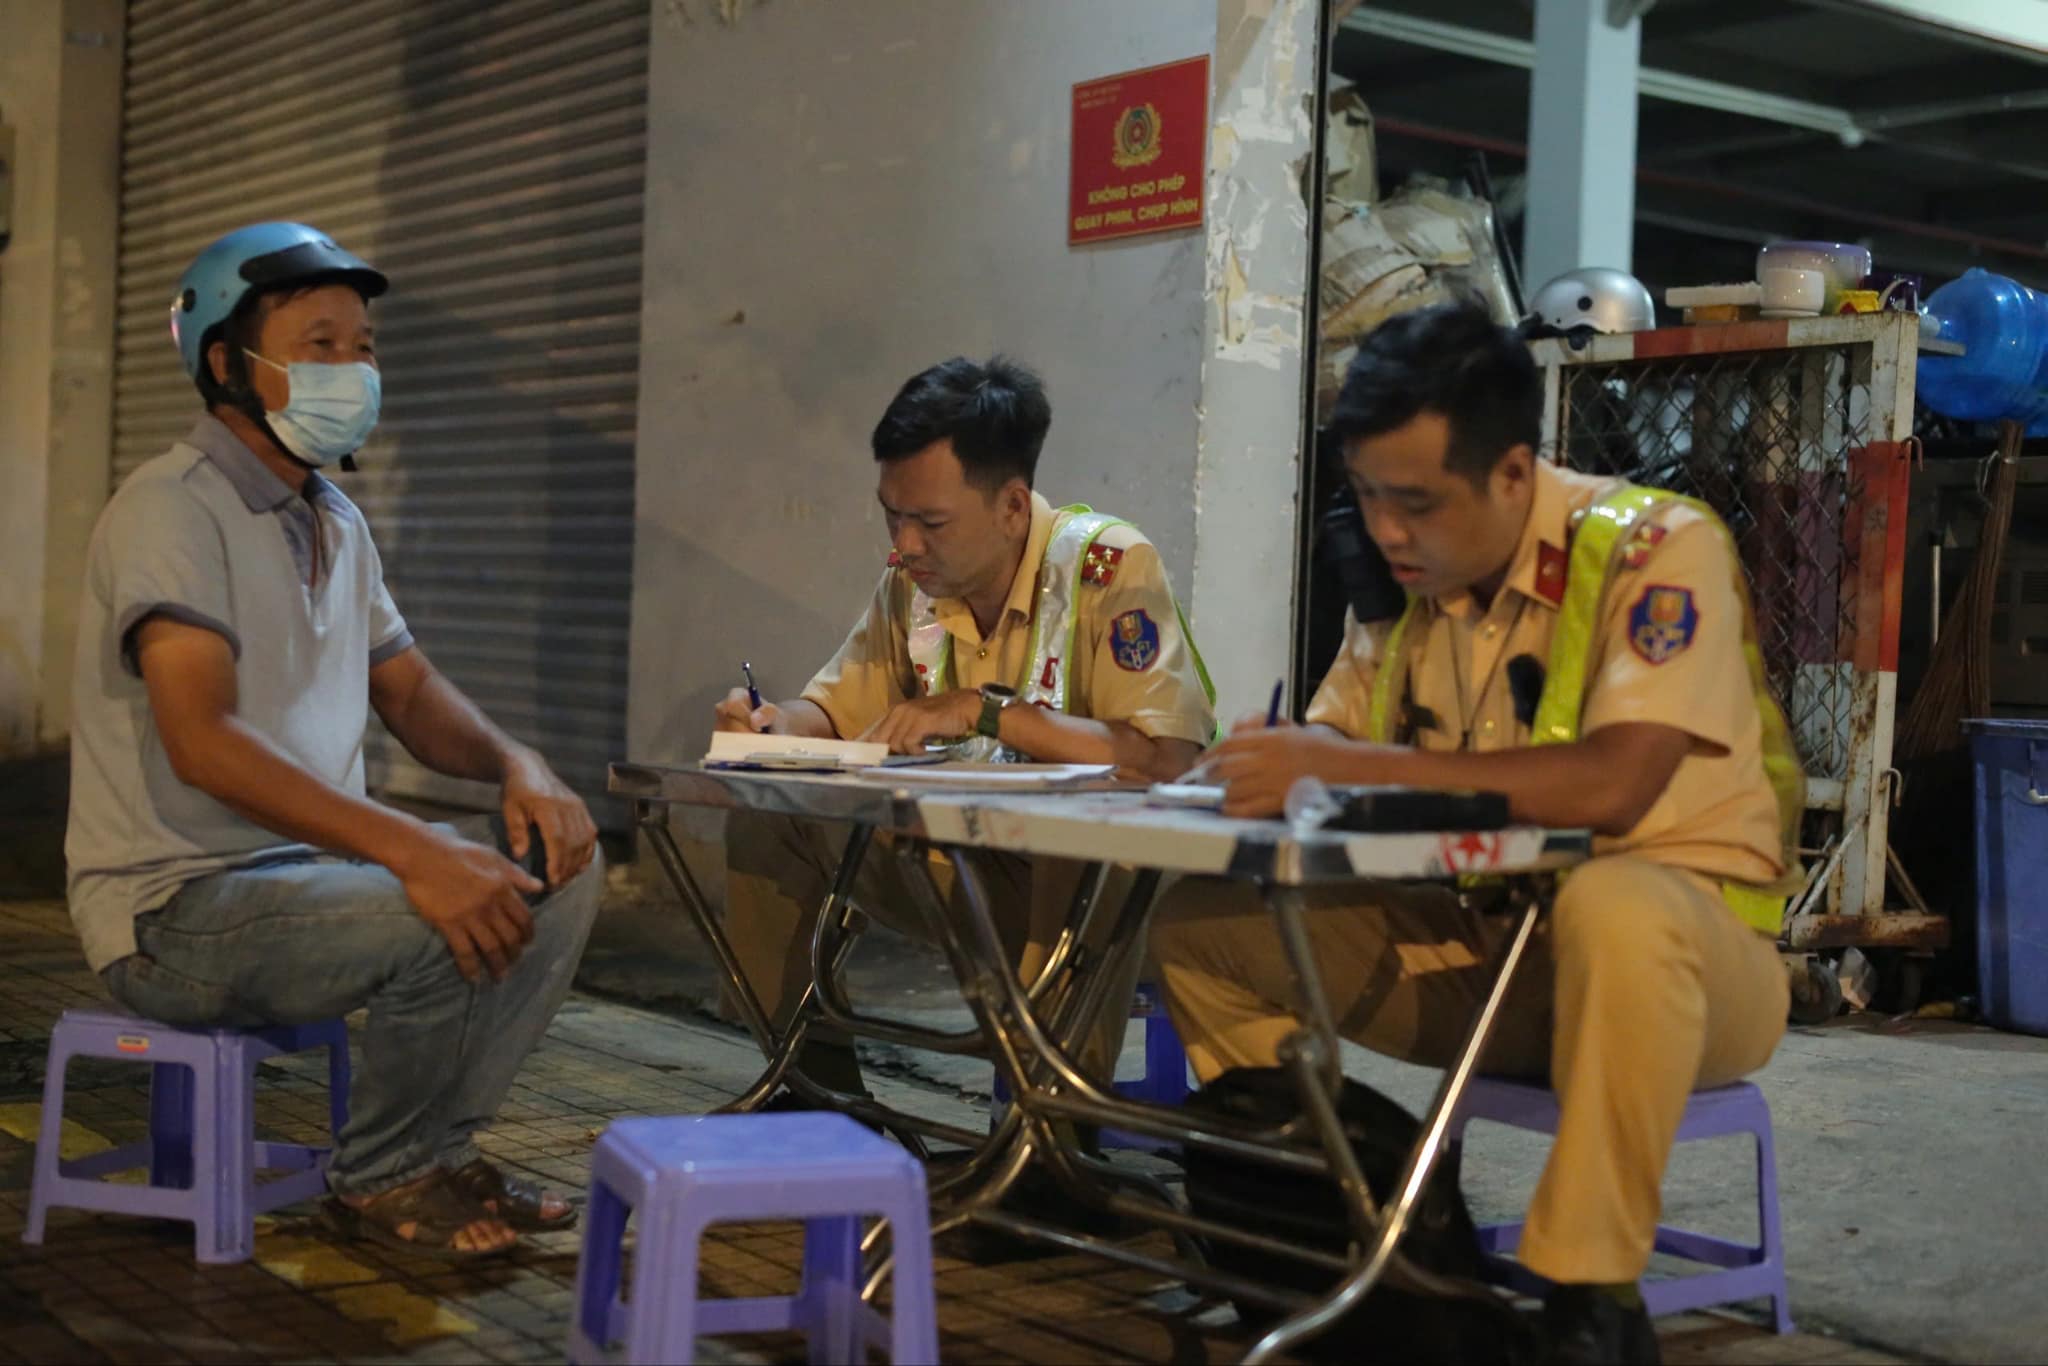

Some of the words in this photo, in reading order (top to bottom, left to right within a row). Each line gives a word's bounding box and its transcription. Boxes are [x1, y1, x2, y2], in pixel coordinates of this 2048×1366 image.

[1089, 186, 1128, 205] KHÔNG
[1132, 182, 1156, 198] CHO
[1159, 173, 1185, 192] PHÉP
[1075, 214, 1103, 231] QUAY
[1138, 204, 1168, 222] CHỤP
[1171, 197, 1198, 216] HÌNH
